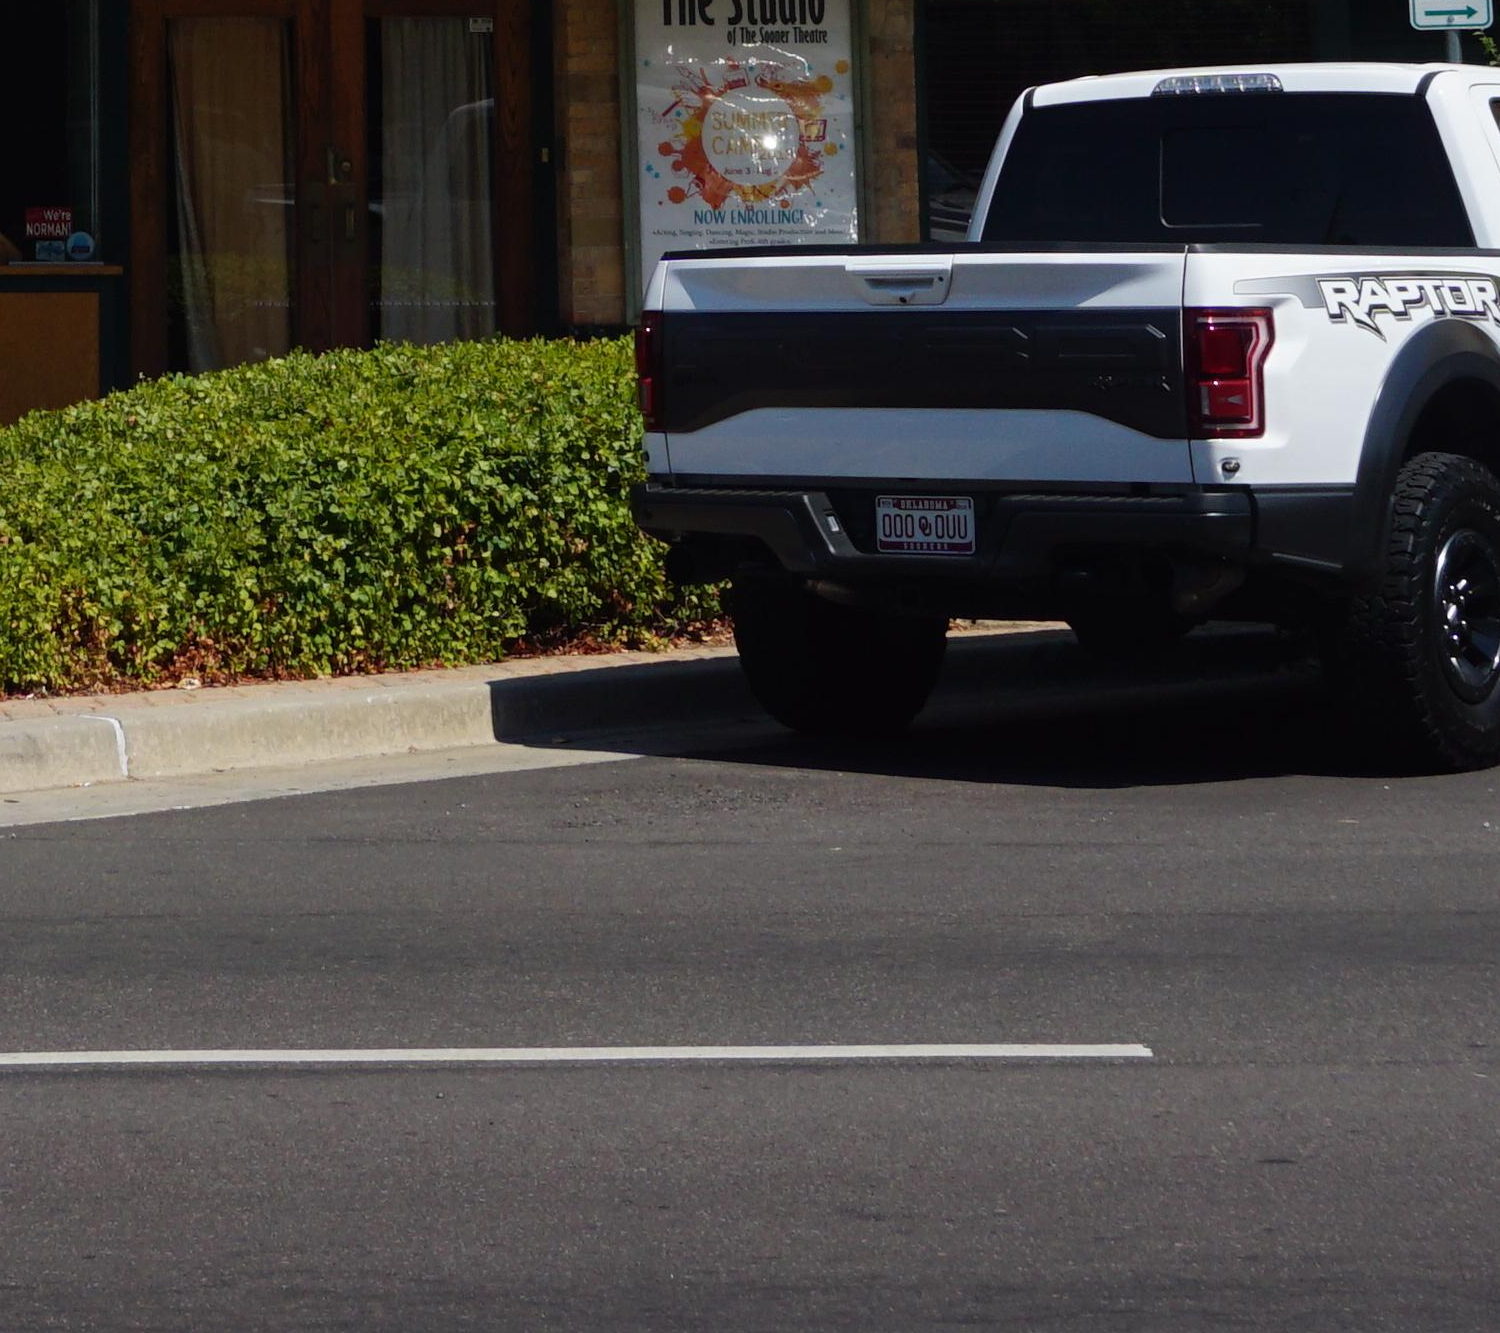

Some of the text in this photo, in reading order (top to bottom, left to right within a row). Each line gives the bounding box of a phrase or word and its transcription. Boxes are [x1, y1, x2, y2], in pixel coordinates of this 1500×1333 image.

[727, 26, 828, 46] of The Sooner Theatre
[43, 208, 72, 221] We're
[694, 208, 804, 225] NOW ENROLLING!
[900, 499, 949, 510] OKLAHOMA
